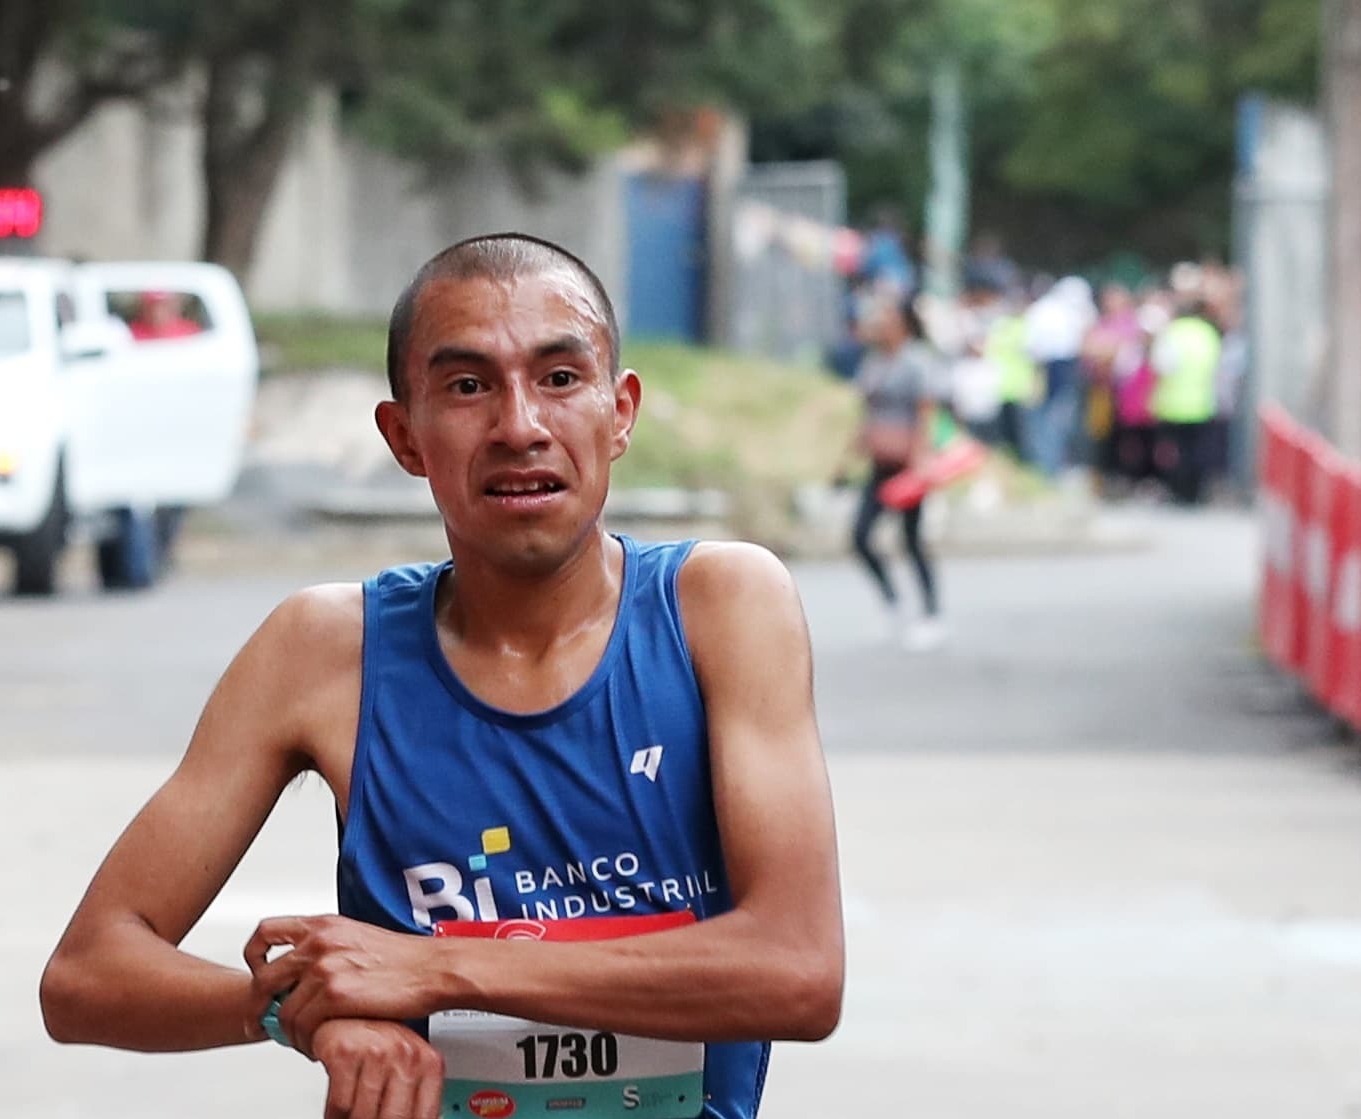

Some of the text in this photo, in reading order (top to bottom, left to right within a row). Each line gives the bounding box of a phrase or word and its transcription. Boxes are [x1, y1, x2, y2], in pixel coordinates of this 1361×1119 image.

[403, 854, 499, 929] Bi
[515, 852, 639, 893] BANCO
[516, 1031, 618, 1079] 1730
